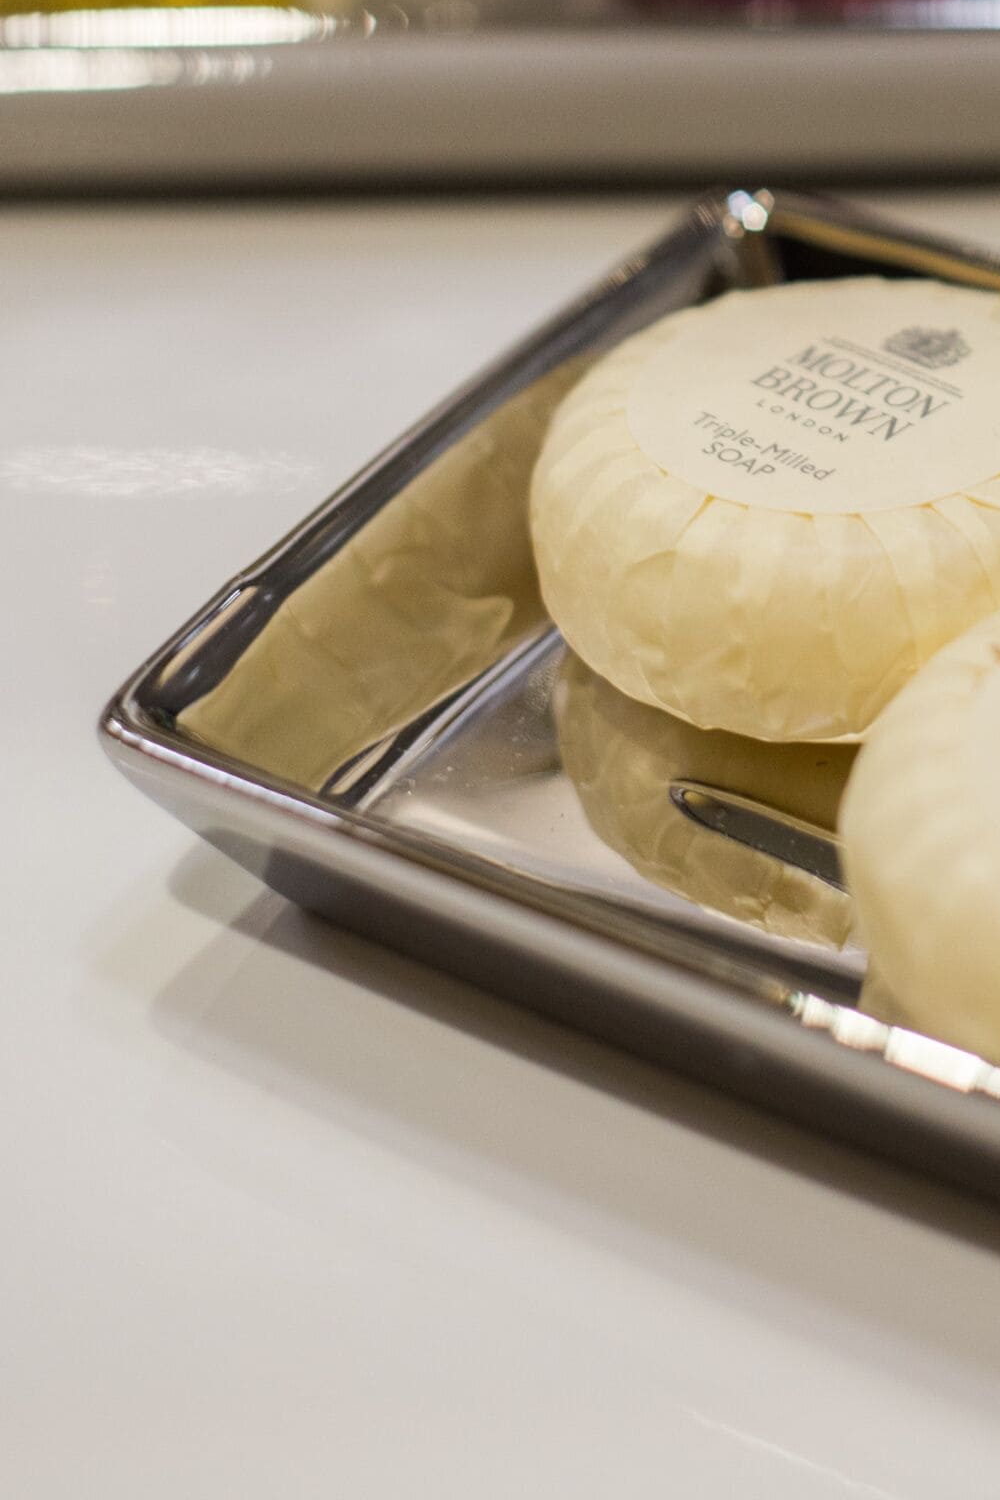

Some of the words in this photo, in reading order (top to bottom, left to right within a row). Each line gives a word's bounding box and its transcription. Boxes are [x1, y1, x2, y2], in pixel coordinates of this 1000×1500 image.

[751, 366, 914, 442] BROWN
[786, 346, 950, 419] MOLTON
[693, 411, 836, 481] Triple-Milled
[756, 399, 850, 443] LONDON
[702, 442, 775, 477] SOAP
